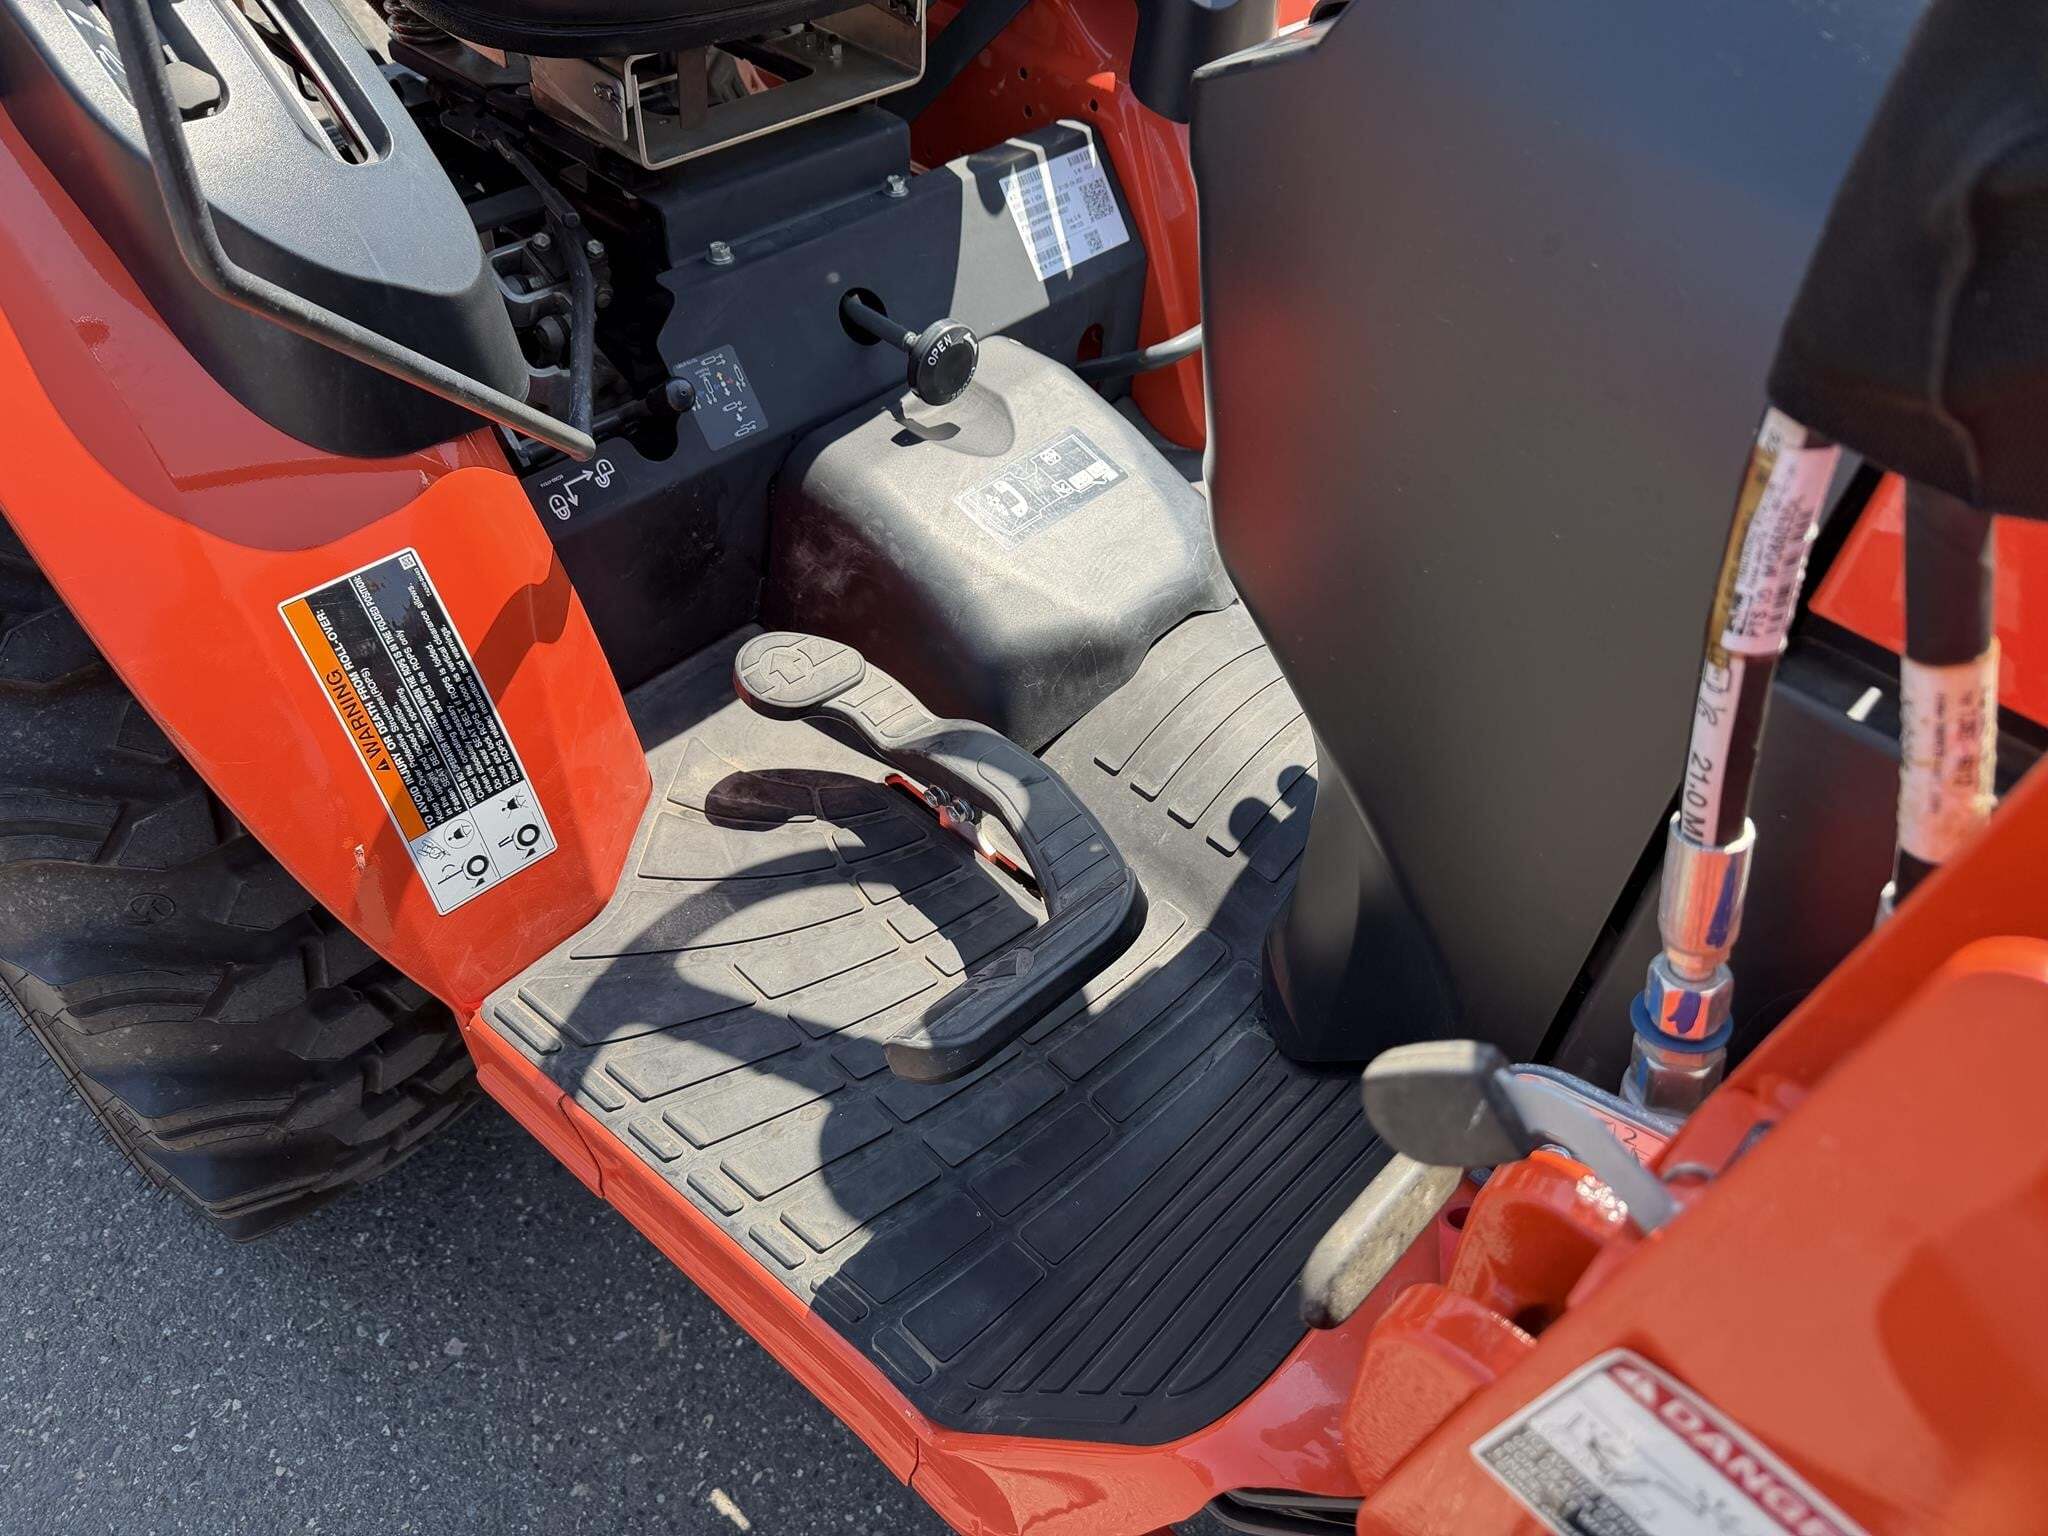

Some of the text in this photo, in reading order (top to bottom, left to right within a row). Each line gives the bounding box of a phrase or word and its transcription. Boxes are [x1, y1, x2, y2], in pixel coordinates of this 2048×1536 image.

[928, 333, 953, 366] OPEN
[354, 575, 374, 606] POSITION:
[407, 582, 423, 608] allows.
[369, 606, 387, 631] FOLDED
[420, 610, 442, 645] clearance
[381, 630, 394, 644] THE
[395, 629, 408, 645] only
[440, 624, 460, 659] warnings.
[393, 650, 402, 659] IS
[403, 646, 420, 670] ROPS
[425, 641, 442, 667] folded.
[437, 646, 455, 672] vertical
[396, 658, 411, 676] ROPS
[438, 667, 446, 675] is
[456, 659, 468, 673] and
[405, 675, 417, 689] THE
[417, 671, 427, 684] the
[412, 687, 426, 706] WHEN
[422, 684, 435, 699] fold
[441, 676, 457, 699] ROPS
[326, 669, 381, 759] WARNING
[430, 699, 443, 713] and
[316, 609, 435, 829] TO AVOID INJURY OR DEATH FROM ROLL-OVER:
[392, 701, 412, 732] position.
[421, 705, 445, 741] PROTECTION
[447, 702, 467, 739] necessary.
[456, 707, 472, 726] BELT
[471, 712, 487, 735] ROPS
[484, 715, 500, 738] related
[406, 732, 422, 756] locked
[467, 728, 482, 748] SEAT
[483, 735, 494, 750] lock
[396, 685, 461, 811] Fasten SEAT BELT before operating.
[396, 733, 416, 767] Protective
[440, 741, 460, 772] OPERATOR
[478, 749, 490, 765] wear
[489, 750, 501, 764] and
[495, 739, 510, 761] ROPS
[418, 756, 430, 770] and
[464, 764, 474, 776] the
[486, 765, 497, 777] not
[505, 761, 519, 780] Read
[455, 771, 465, 781] NO
[459, 780, 468, 788] IS
[480, 774, 492, 793] when
[493, 778, 502, 789] Do
[498, 765, 510, 784] Raise
[1685, 751, 1712, 808] 21.0
[462, 786, 476, 806] THERE
[470, 776, 484, 798] Check
[440, 795, 449, 807] the
[431, 802, 444, 820] Keep
